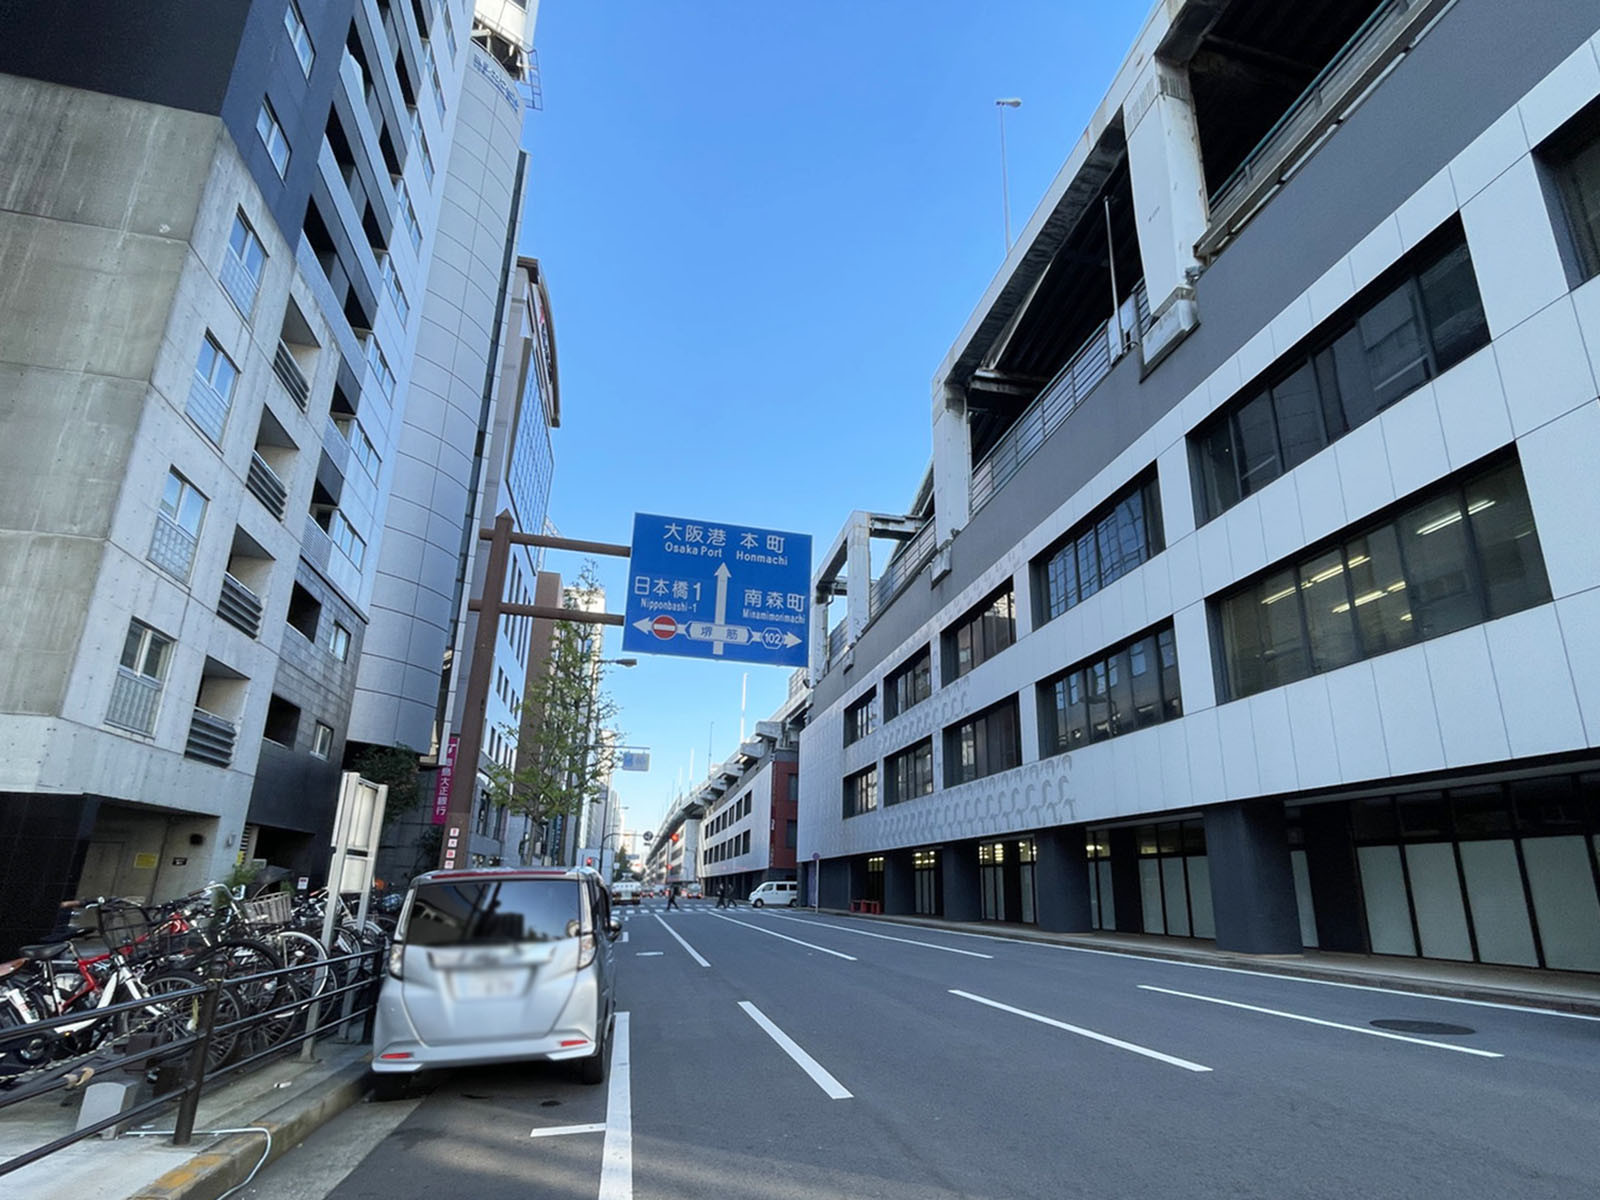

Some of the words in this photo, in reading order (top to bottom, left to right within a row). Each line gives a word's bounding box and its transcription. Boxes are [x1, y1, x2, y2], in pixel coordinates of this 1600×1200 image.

[663, 522, 727, 547] 大阪港
[740, 532, 785, 554] 本町
[664, 541, 699, 556] Osaka
[700, 547, 722, 558] Port
[736, 551, 788, 566] Honmachi
[634, 576, 701, 601] 日本橋1
[640, 598, 697, 612] Nipponbashi-1
[744, 588, 806, 612] 南森町
[742, 609, 806, 624] Minamimorimachi
[764, 633, 781, 645] 102
